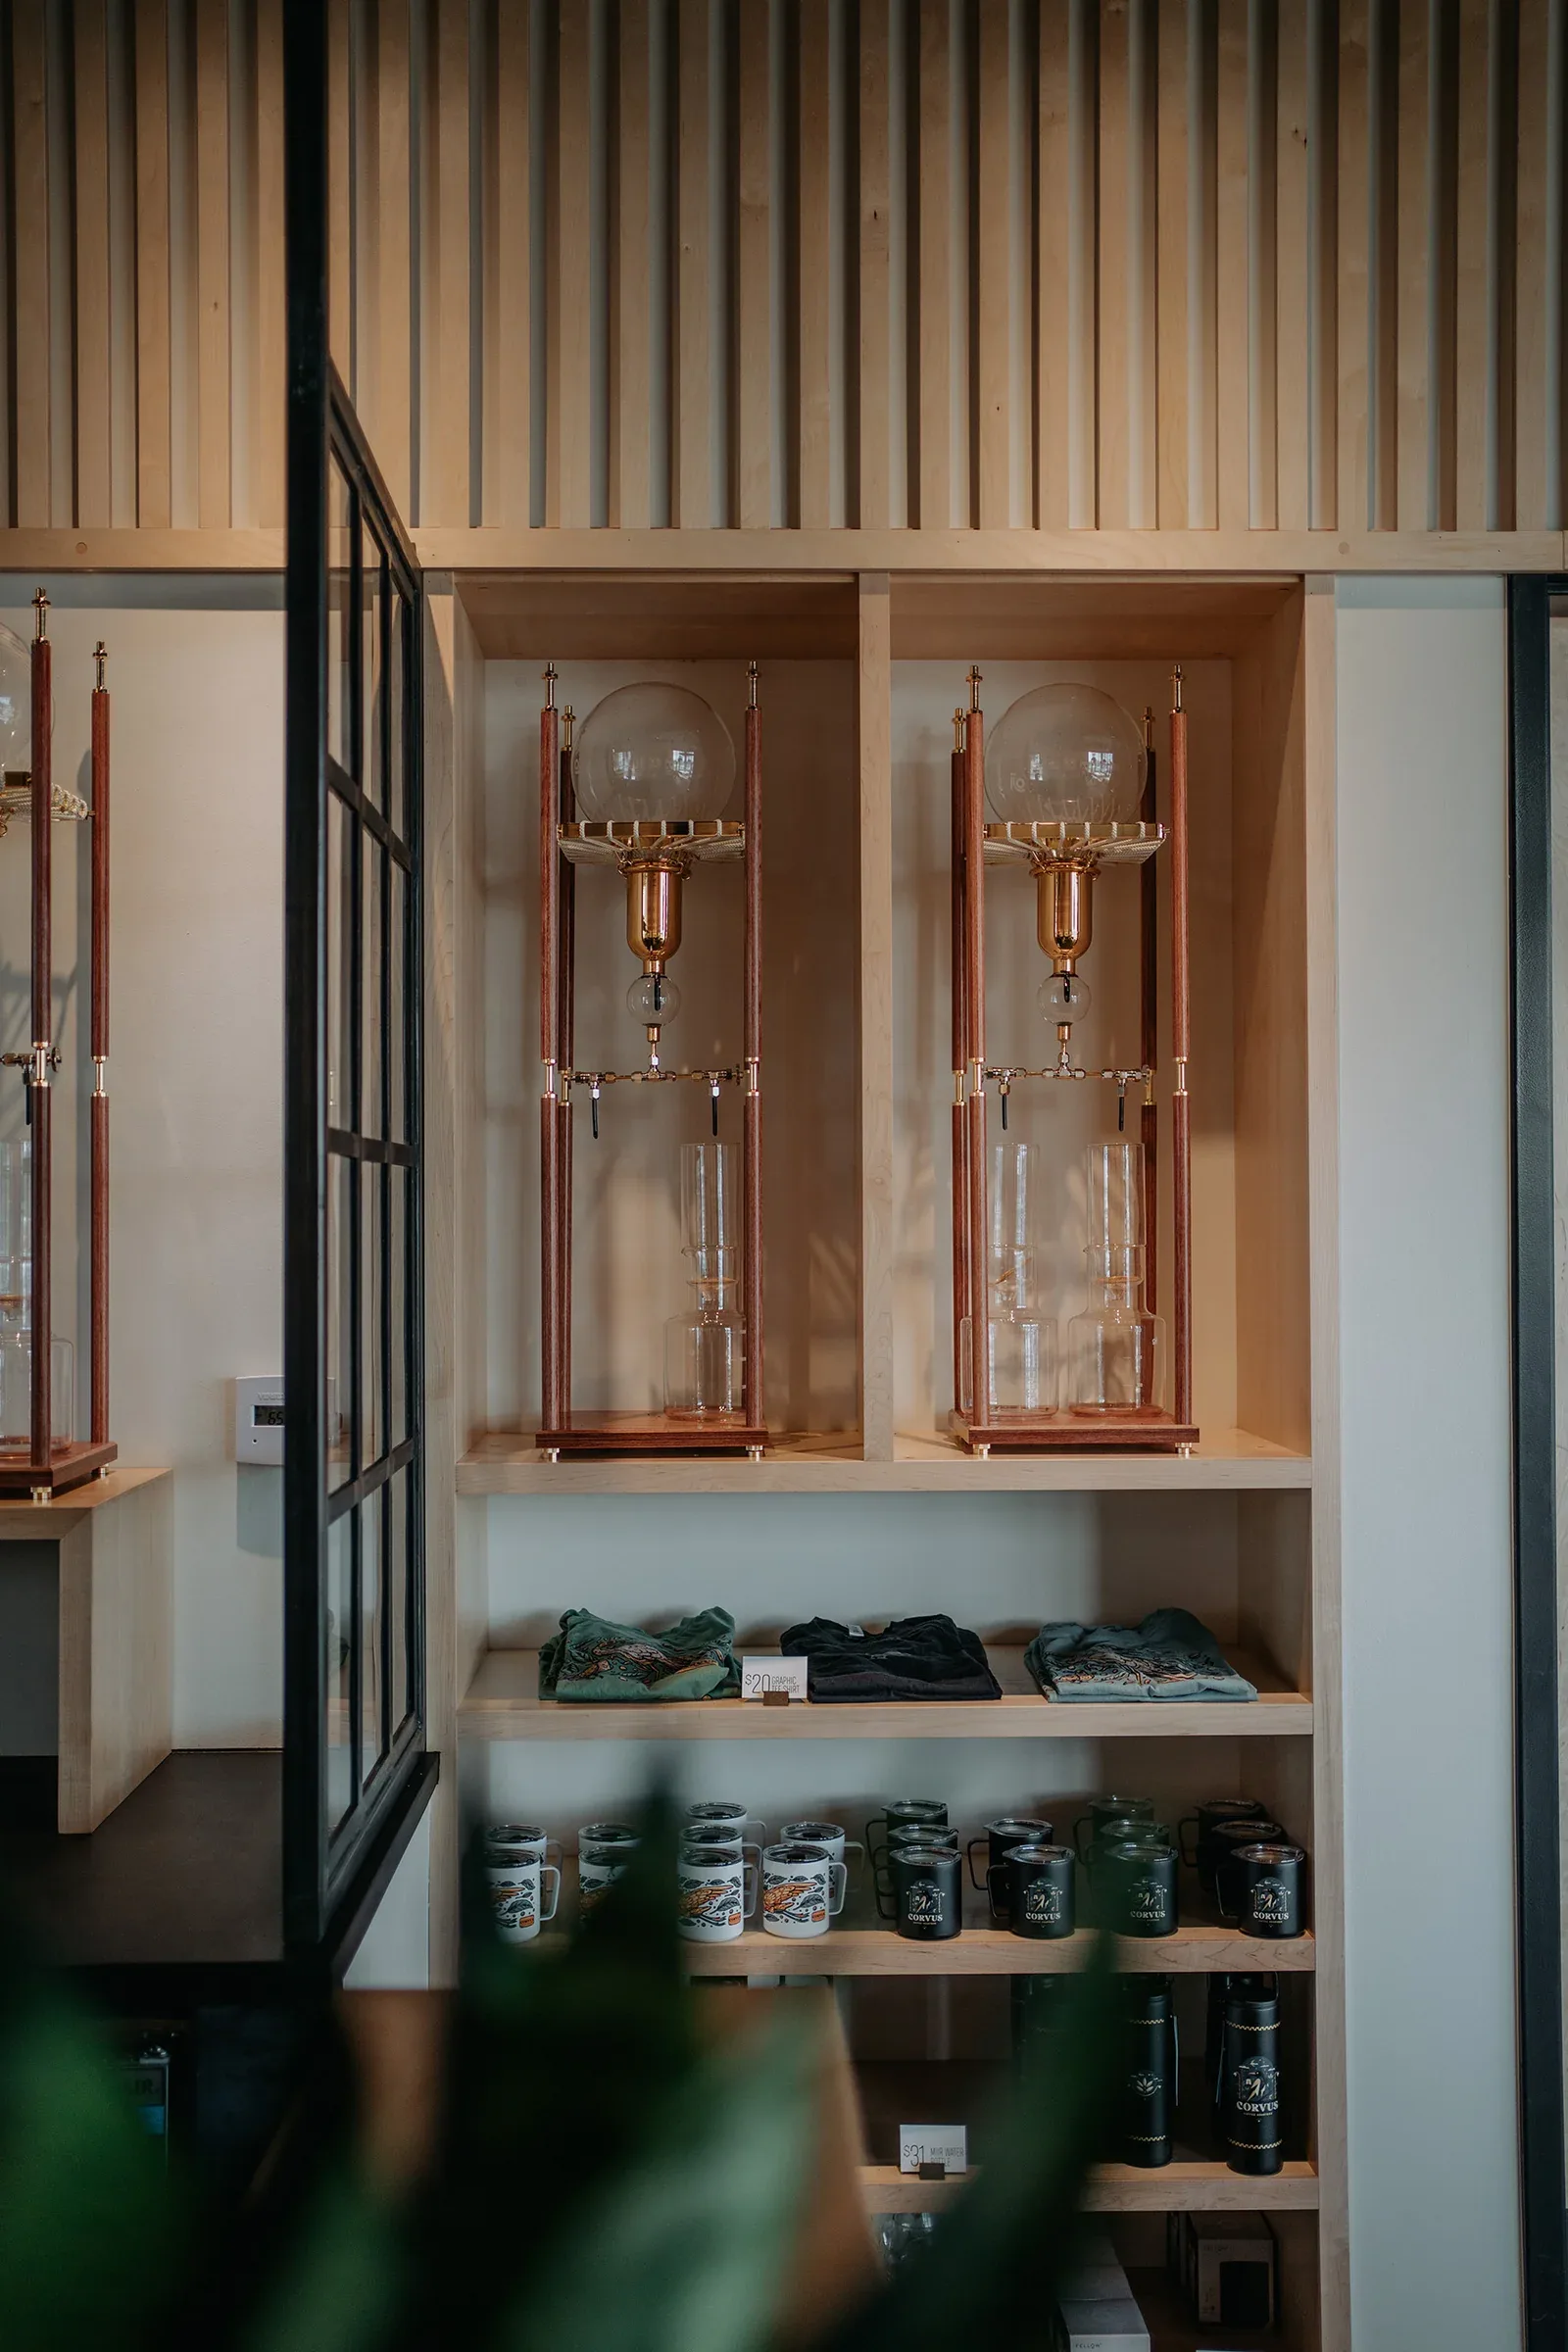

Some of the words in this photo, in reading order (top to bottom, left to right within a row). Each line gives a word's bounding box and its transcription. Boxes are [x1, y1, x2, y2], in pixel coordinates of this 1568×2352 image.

[745, 1674, 770, 1693] $20
[772, 1676, 797, 1685] GRAPHIC
[783, 1685, 800, 1693] SHIRT
[907, 1913, 943, 1922] CORVUS
[1025, 1912, 1061, 1921] CORVUS
[1130, 1910, 1166, 1919] CORVUS
[1252, 1911, 1290, 1921] CORVUS
[1236, 2100, 1279, 2113] CORVUS
[904, 2144, 924, 2167] $31
[945, 2147, 964, 2157] WATER
